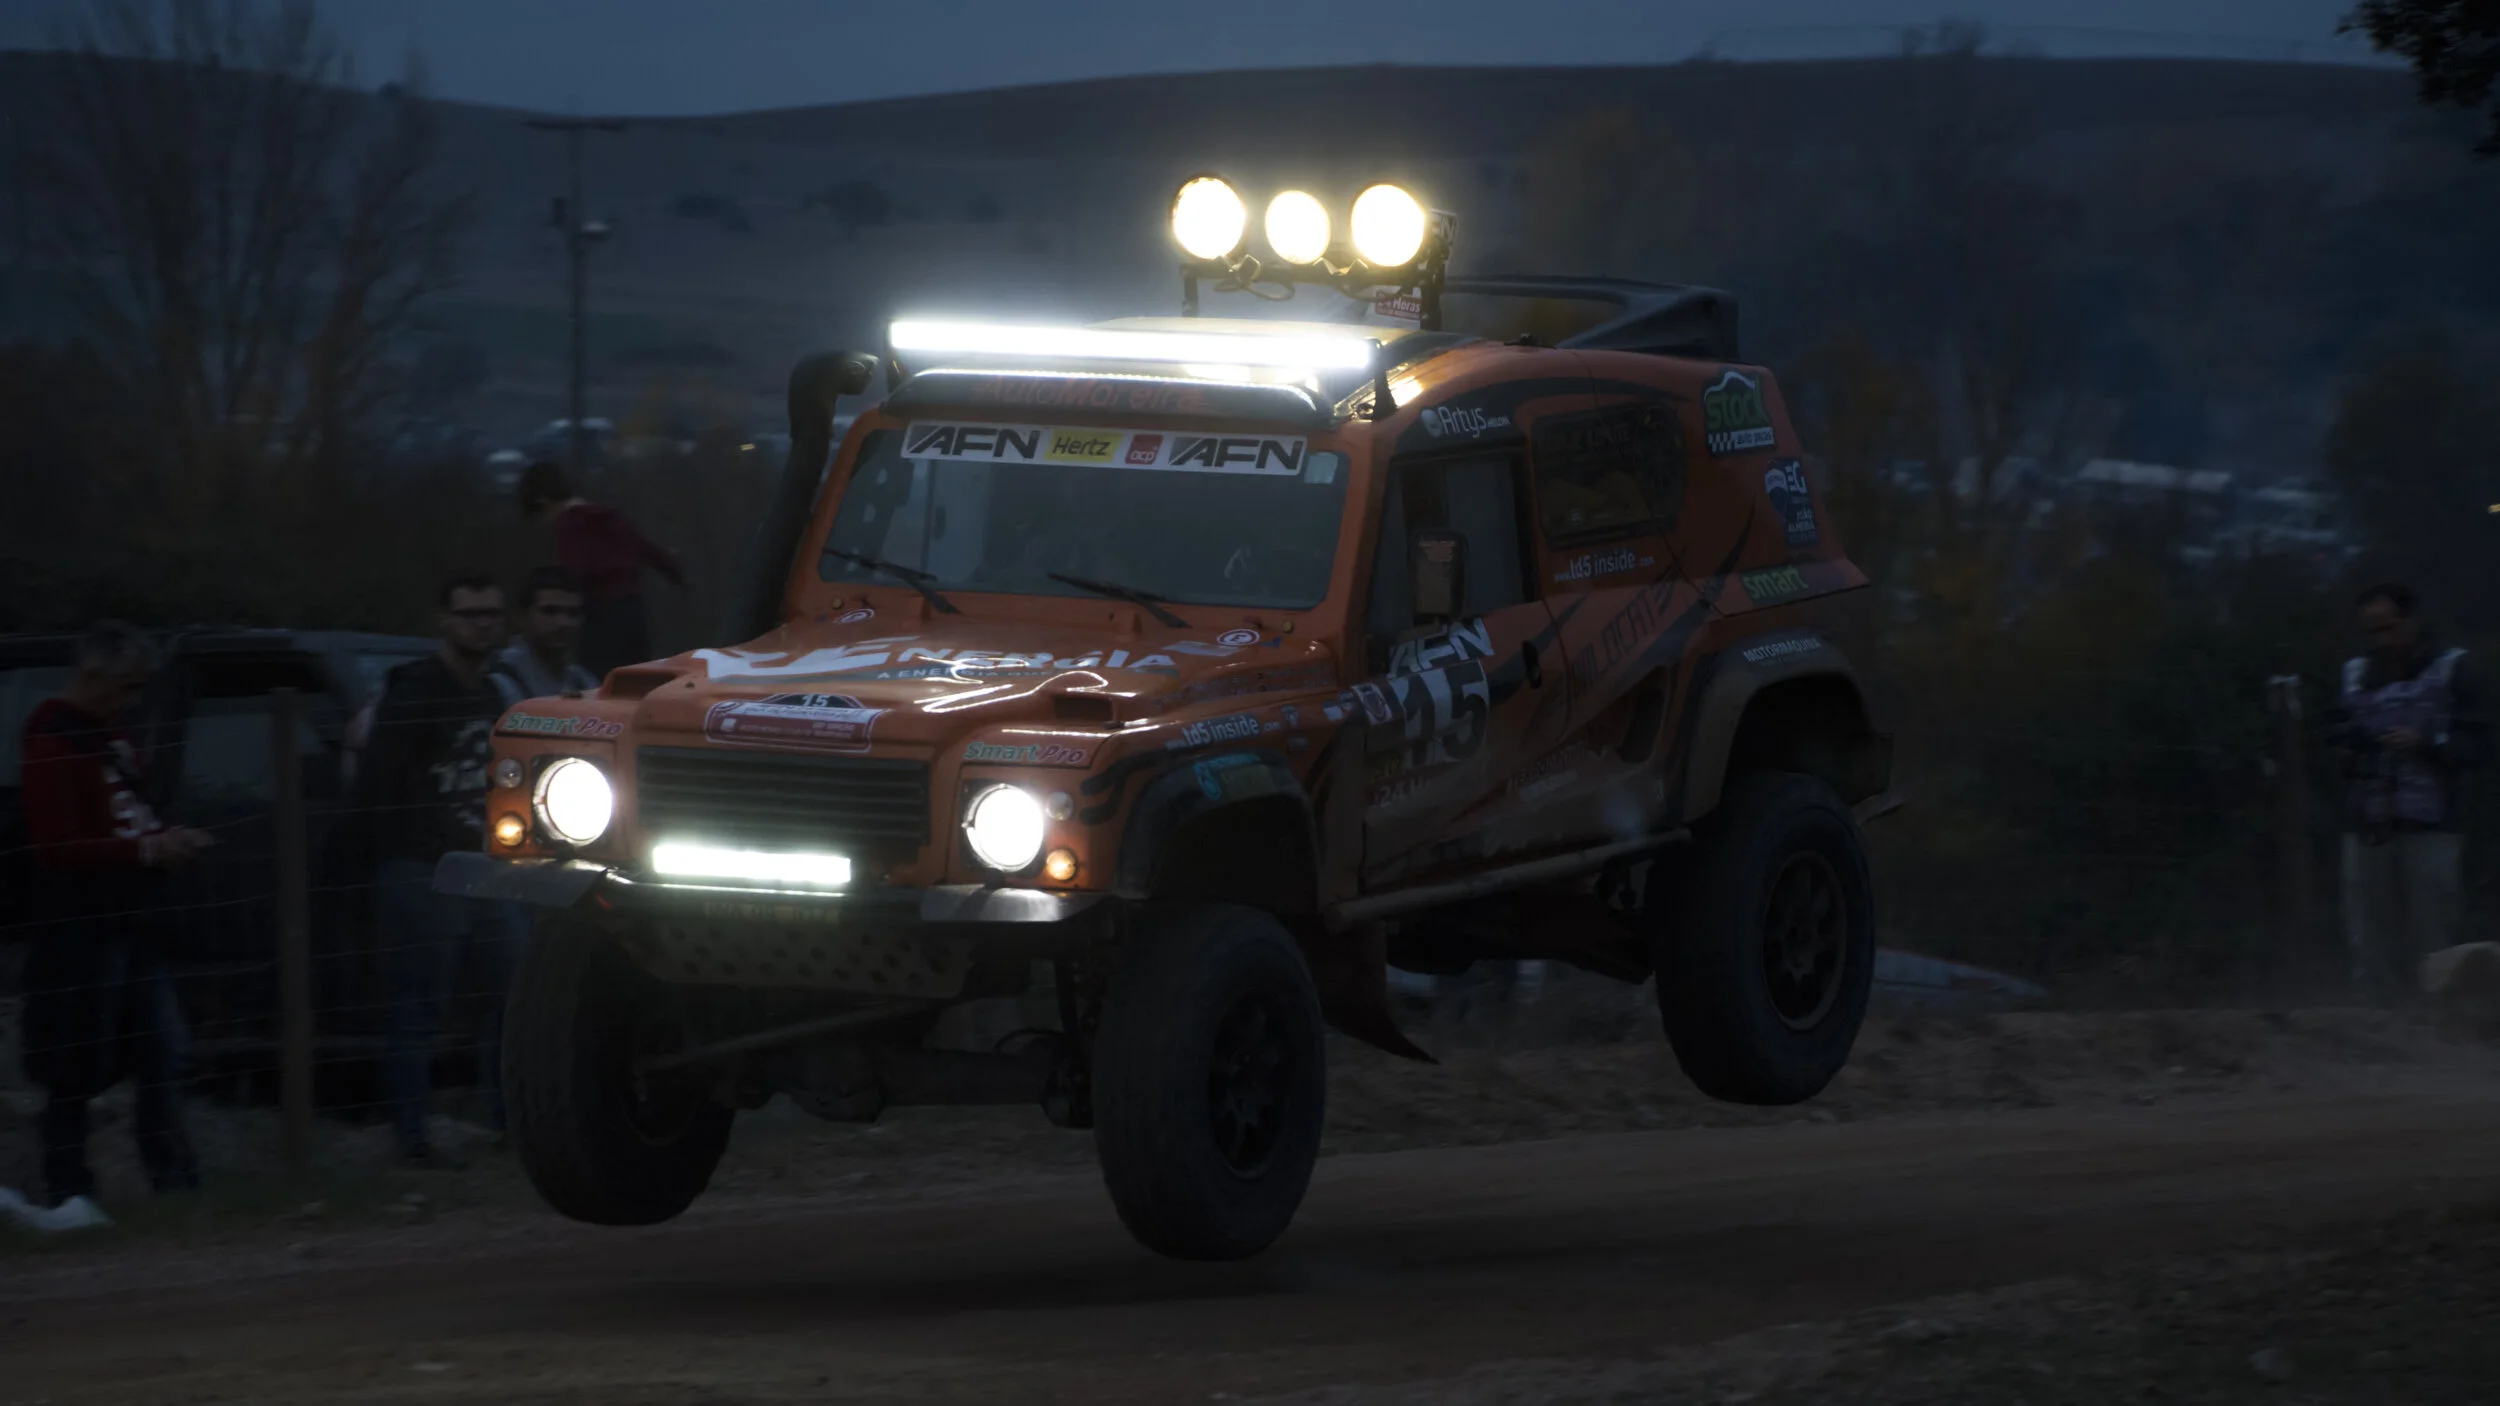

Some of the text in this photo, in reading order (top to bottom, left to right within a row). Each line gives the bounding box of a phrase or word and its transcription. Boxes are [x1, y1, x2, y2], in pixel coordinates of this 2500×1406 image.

[1438, 406, 1488, 439] Artys
[907, 426, 1041, 459] AFN
[1051, 436, 1111, 458] Hertz
[1169, 437, 1304, 470] AFN
[1387, 616, 1496, 679] AFN
[801, 695, 829, 707] 15
[1402, 661, 1488, 768] 15
